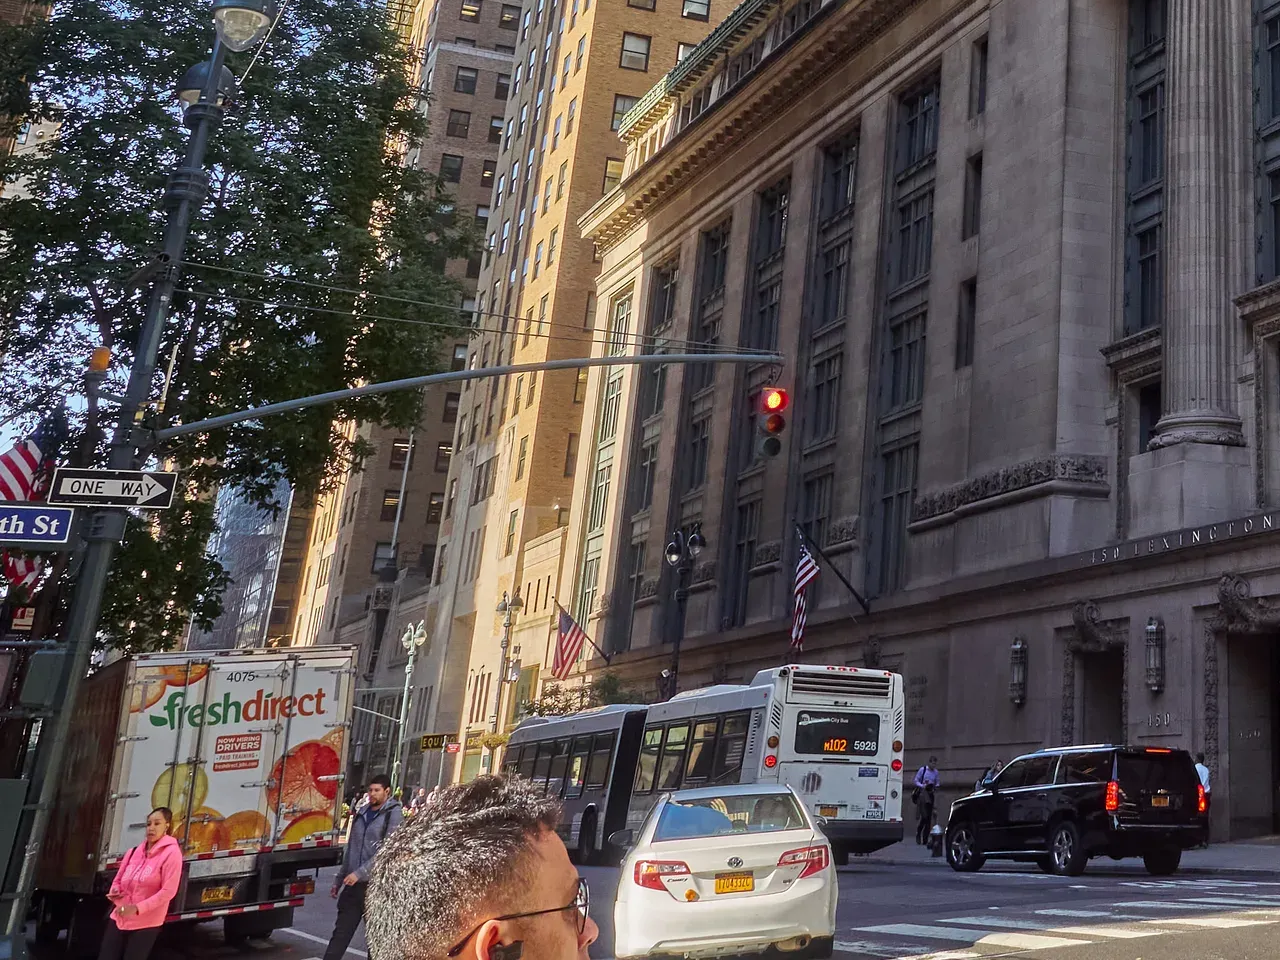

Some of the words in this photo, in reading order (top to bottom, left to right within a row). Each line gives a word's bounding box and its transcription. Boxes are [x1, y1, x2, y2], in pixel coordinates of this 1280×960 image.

[70, 479, 104, 495] ONE
[121, 481, 157, 497] WAY
[32, 515, 60, 535] St
[1090, 545, 1120, 565] 450
[1133, 514, 1274, 556] LEXINGTON
[226, 670, 255, 683] 4075
[152, 687, 327, 730] freshdirect
[1146, 712, 1171, 728] 450
[217, 741, 260, 752] DRIVERS
[824, 738, 847, 752] M102
[853, 740, 877, 751] 5928
